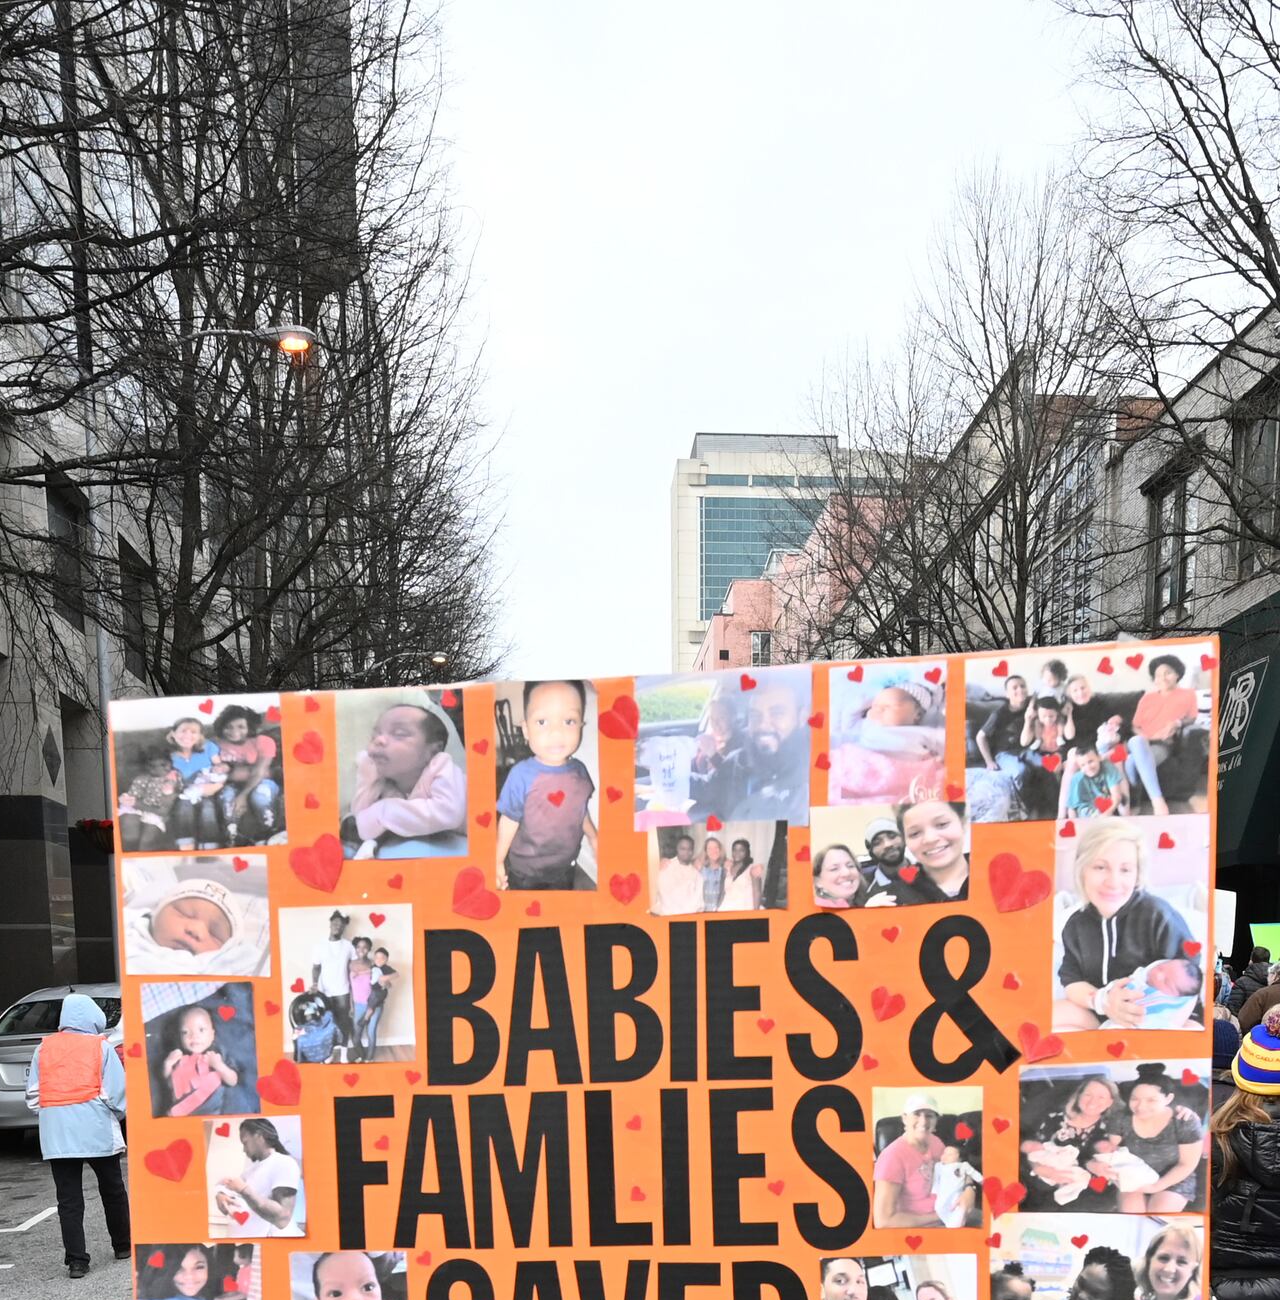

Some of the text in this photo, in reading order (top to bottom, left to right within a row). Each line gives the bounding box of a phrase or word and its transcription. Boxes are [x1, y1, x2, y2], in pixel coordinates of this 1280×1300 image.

[425, 913, 1022, 1085] BABIES &
[335, 1085, 869, 1249] FAMLIES
